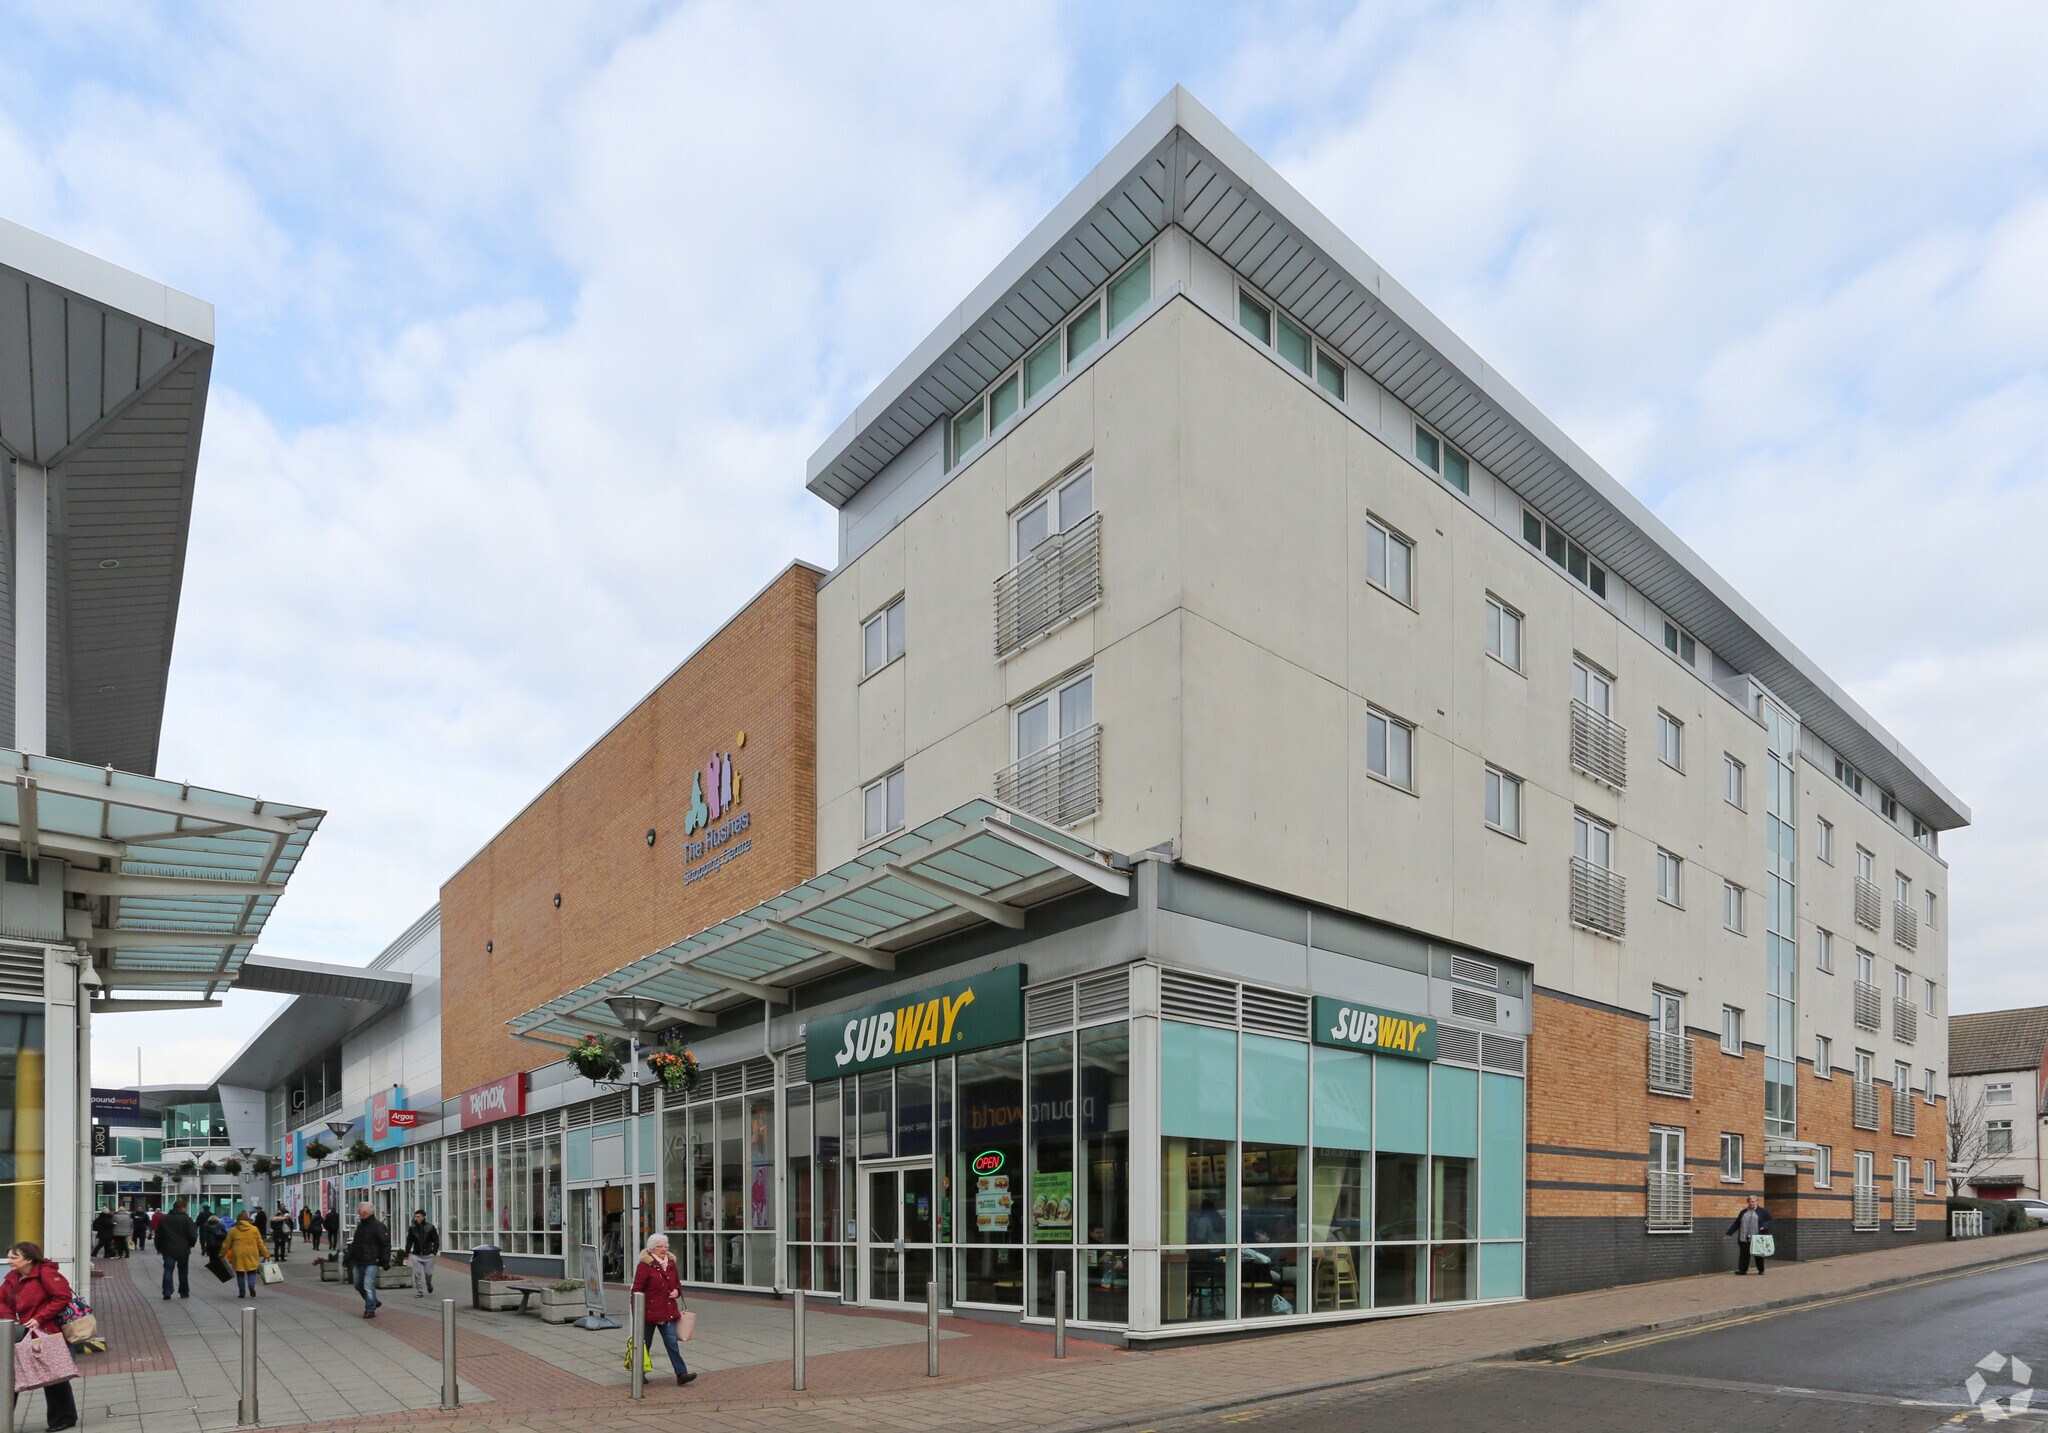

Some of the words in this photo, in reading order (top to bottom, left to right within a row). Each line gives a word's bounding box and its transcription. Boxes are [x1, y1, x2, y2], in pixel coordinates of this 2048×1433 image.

[683, 840, 704, 863] The
[706, 810, 751, 853] Rushes
[835, 986, 975, 1068] SUBWAY
[1331, 1007, 1427, 1052] SUBWAY
[391, 1112, 414, 1121] Argos
[95, 1126, 106, 1154] next
[976, 1156, 999, 1169] OPEN
